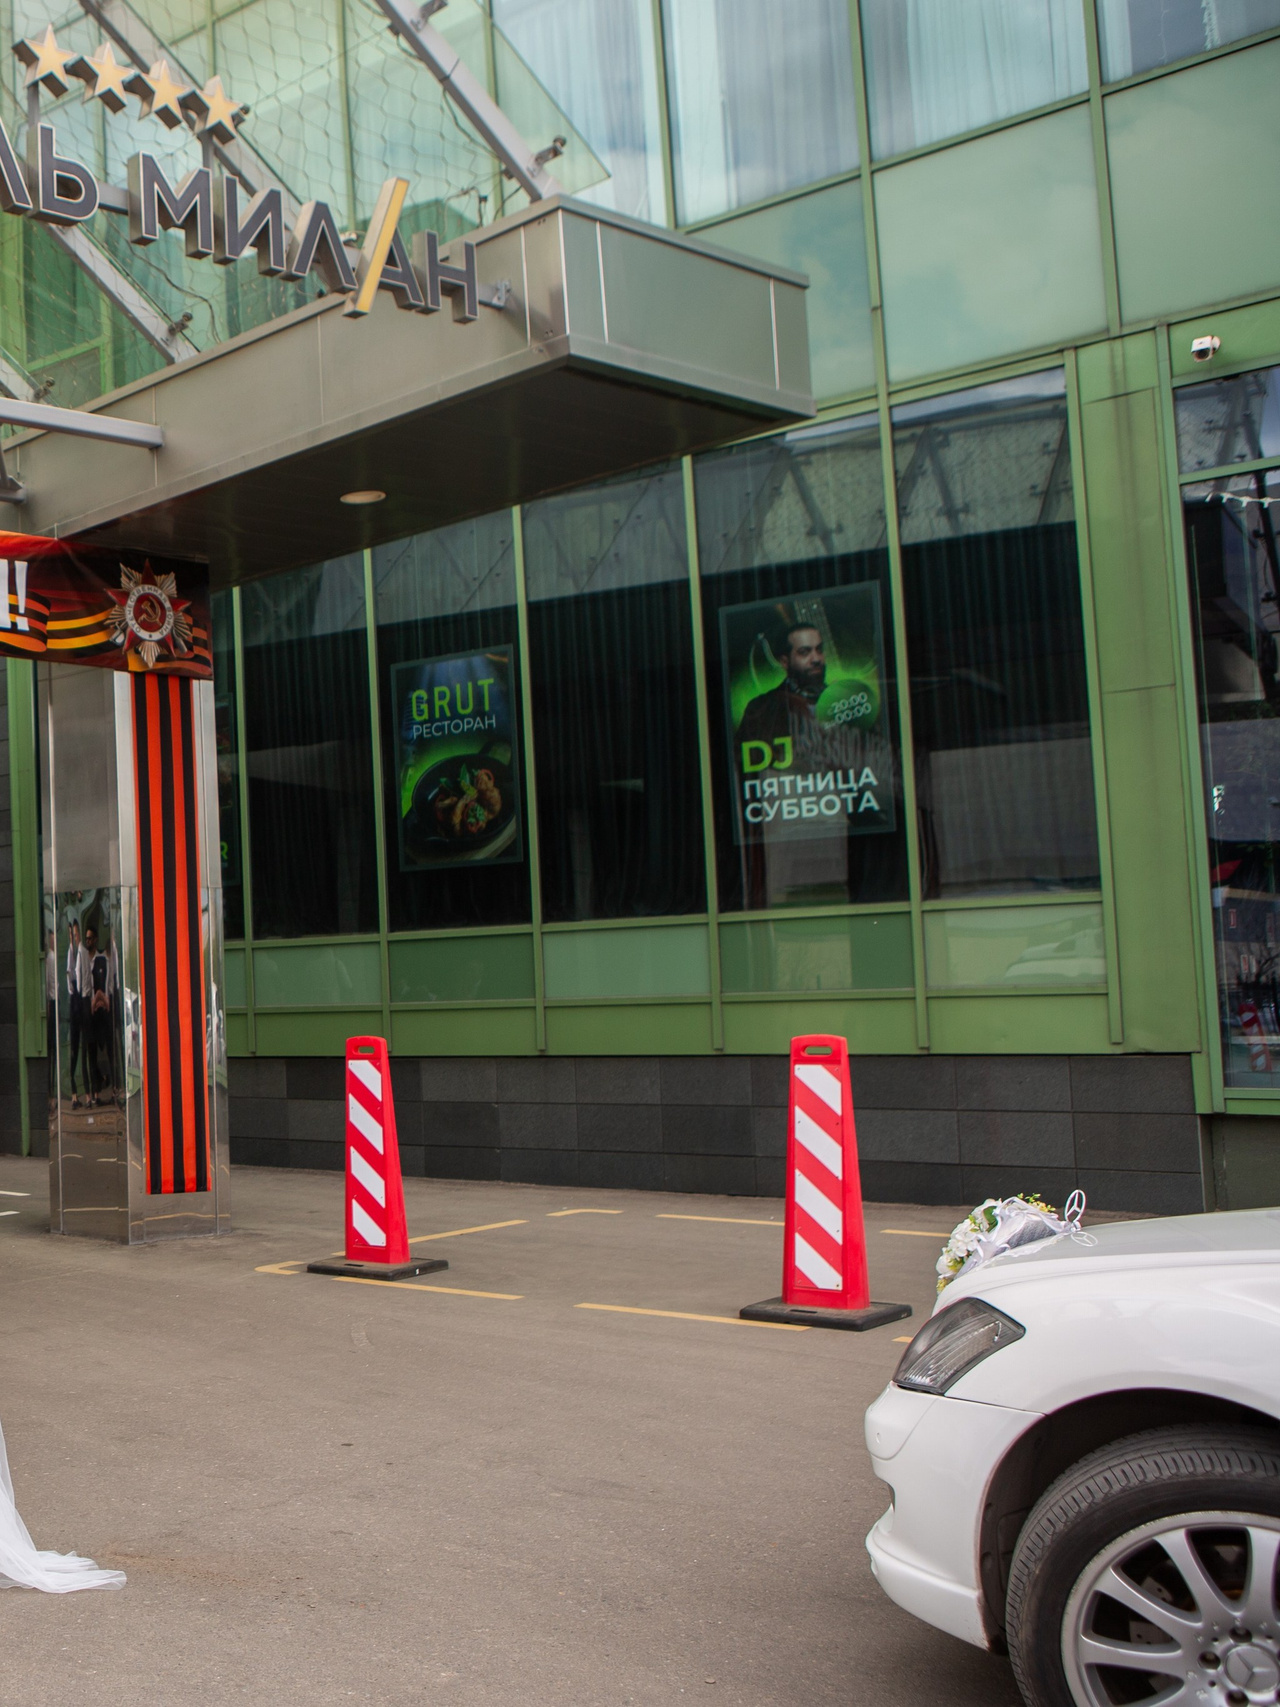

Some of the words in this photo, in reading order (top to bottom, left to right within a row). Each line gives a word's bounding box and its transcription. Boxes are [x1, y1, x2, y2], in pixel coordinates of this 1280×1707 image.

[129, 149, 480, 324] МИЛАН
[412, 679, 495, 721] GRUT
[413, 715, 496, 739] РЕСТОРАН
[742, 736, 793, 773] DJ
[744, 767, 878, 799] ПЯТНИЦА
[745, 791, 880, 822] СУББОТА
